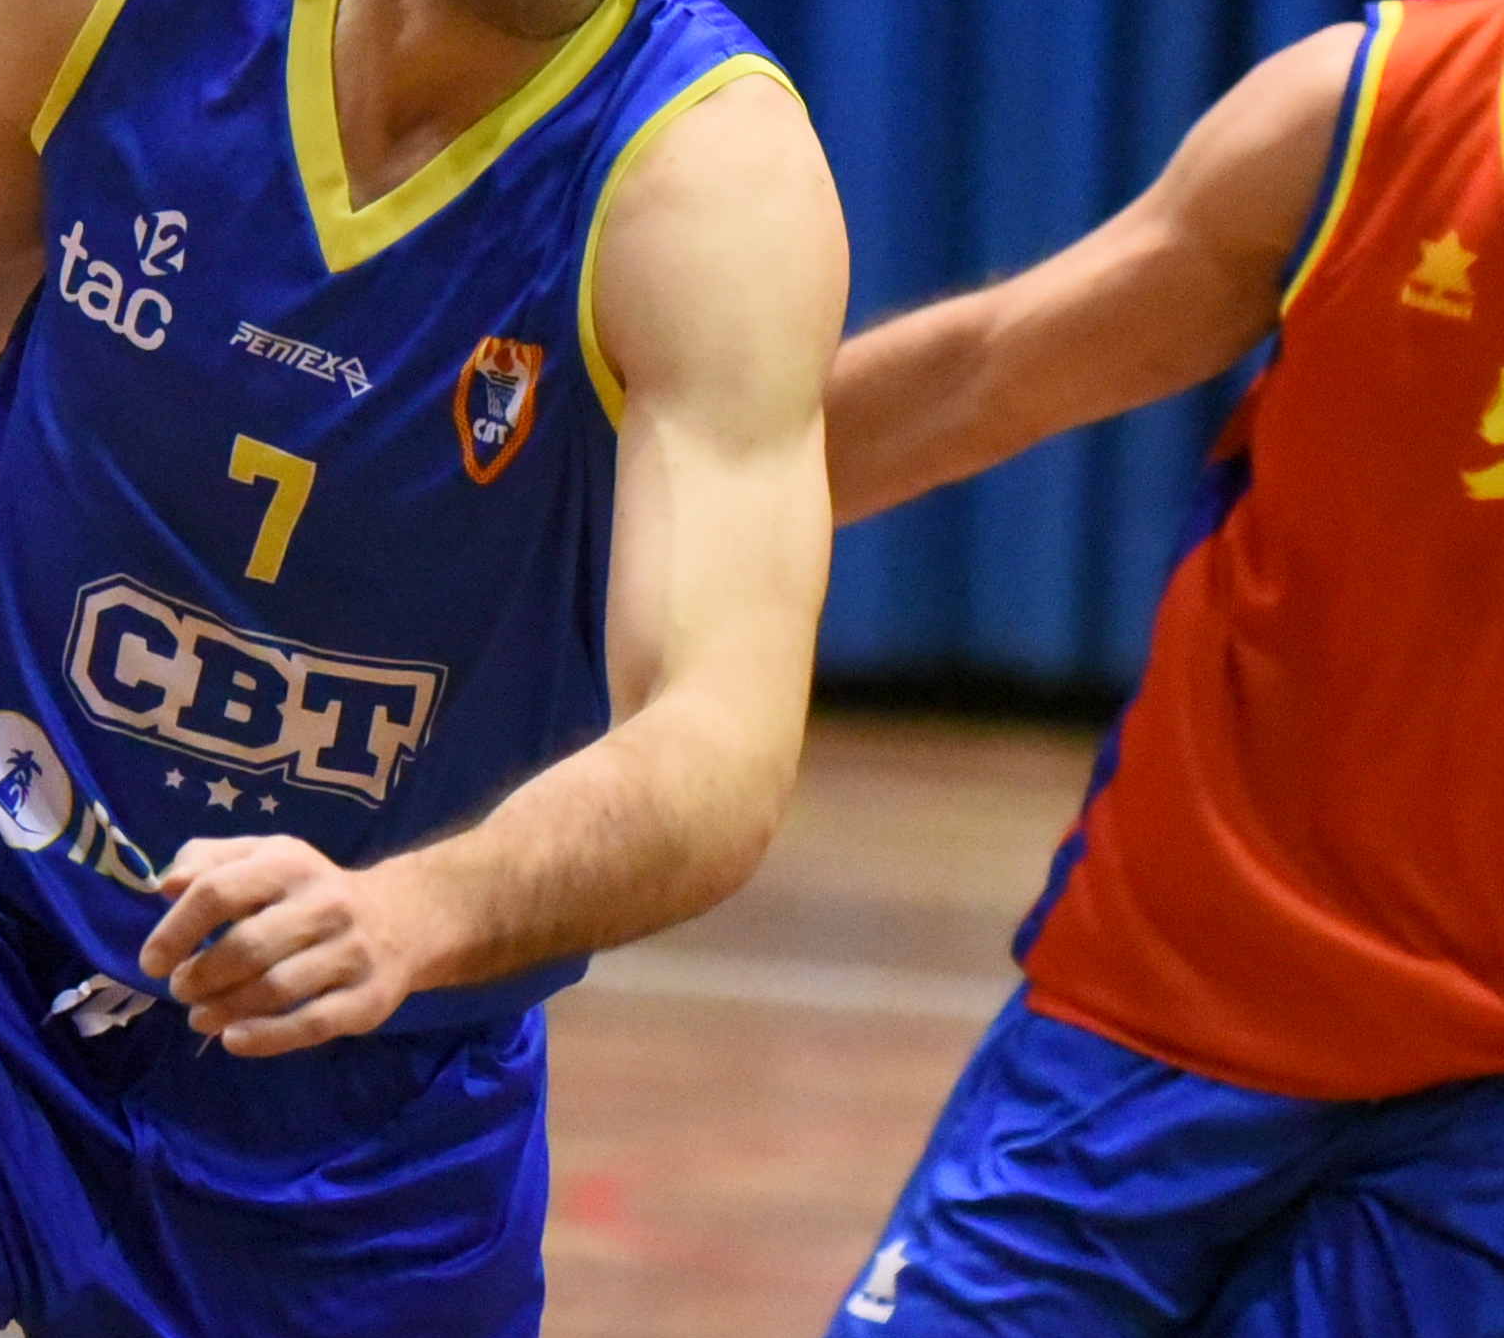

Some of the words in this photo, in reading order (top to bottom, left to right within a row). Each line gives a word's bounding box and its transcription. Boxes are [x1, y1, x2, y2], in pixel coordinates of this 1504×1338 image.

[58, 220, 173, 351] tac
[229, 321, 342, 382] PENTEX
[228, 433, 317, 584] 7
[68, 587, 438, 801] CBT
